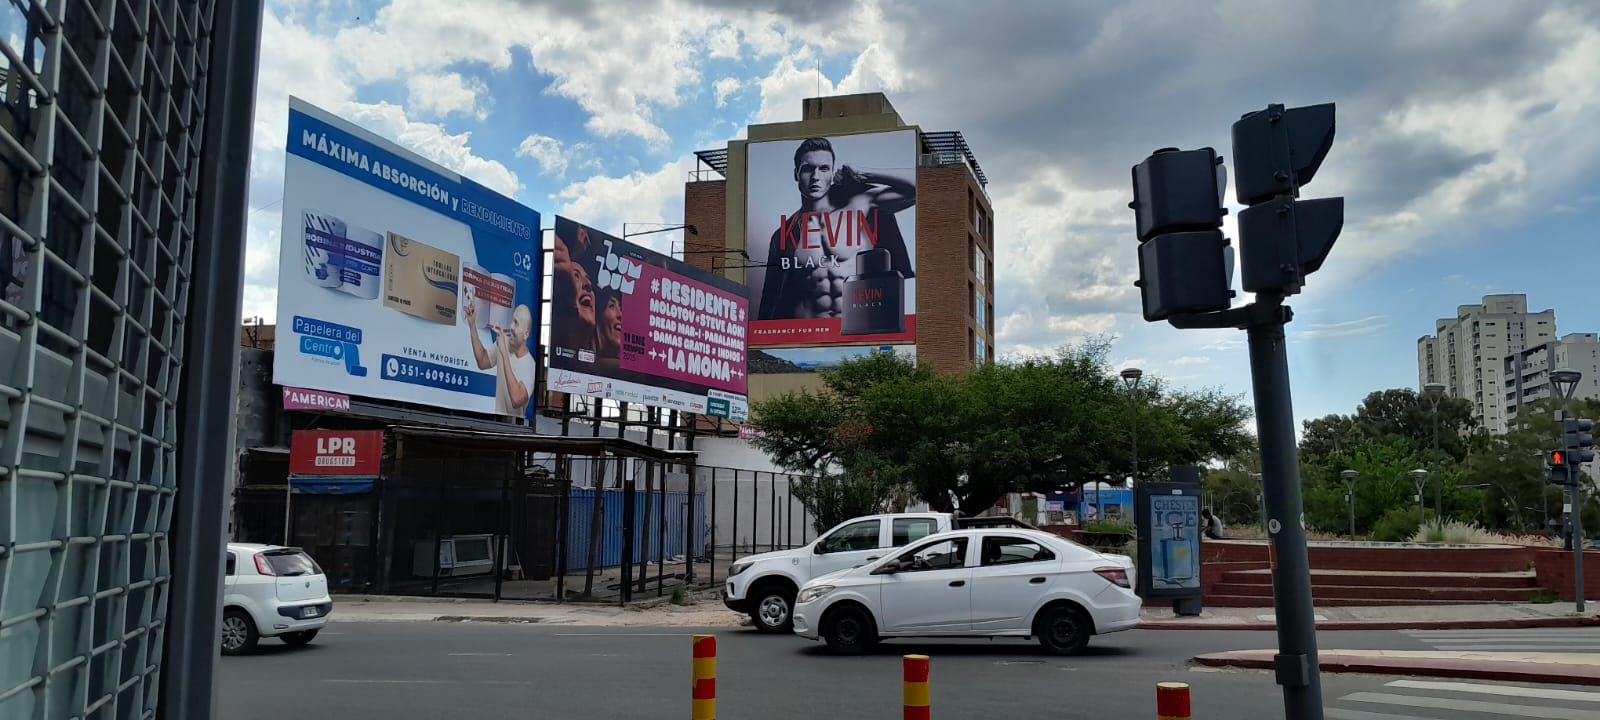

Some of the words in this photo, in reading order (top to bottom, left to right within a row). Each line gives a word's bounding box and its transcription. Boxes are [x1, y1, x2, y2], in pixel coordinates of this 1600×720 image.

[302, 129, 370, 171] MÁXIMA
[372, 161, 449, 206] ABSORCIÓN
[461, 198, 531, 240] RENDIMIENTO
[779, 207, 879, 250] KEVIN
[781, 254, 841, 270] BLACK
[662, 277, 738, 322] RESIDENTE
[853, 287, 882, 300] KEVIN
[650, 299, 694, 322] MOLOTOV
[700, 314, 726, 332] STEVE
[727, 320, 745, 336] AOKI
[296, 318, 342, 338] Papelera
[345, 329, 360, 342] del
[650, 315, 676, 332] DREAD
[704, 330, 744, 351] PARALAMAS
[403, 346, 427, 359] VENTA
[430, 351, 469, 367] MAYORISTA
[654, 330, 683, 347] DAMAS
[684, 338, 711, 355] GRATIS
[718, 347, 741, 362] INDIOS
[400, 365, 469, 387] 351-6095663
[668, 347, 686, 373] LA
[688, 353, 730, 382] MONA
[291, 391, 350, 409] AMERICAN
[317, 437, 355, 455] LPR
[1154, 500, 1197, 511] CHESTER
[1155, 511, 1196, 527] ICE
